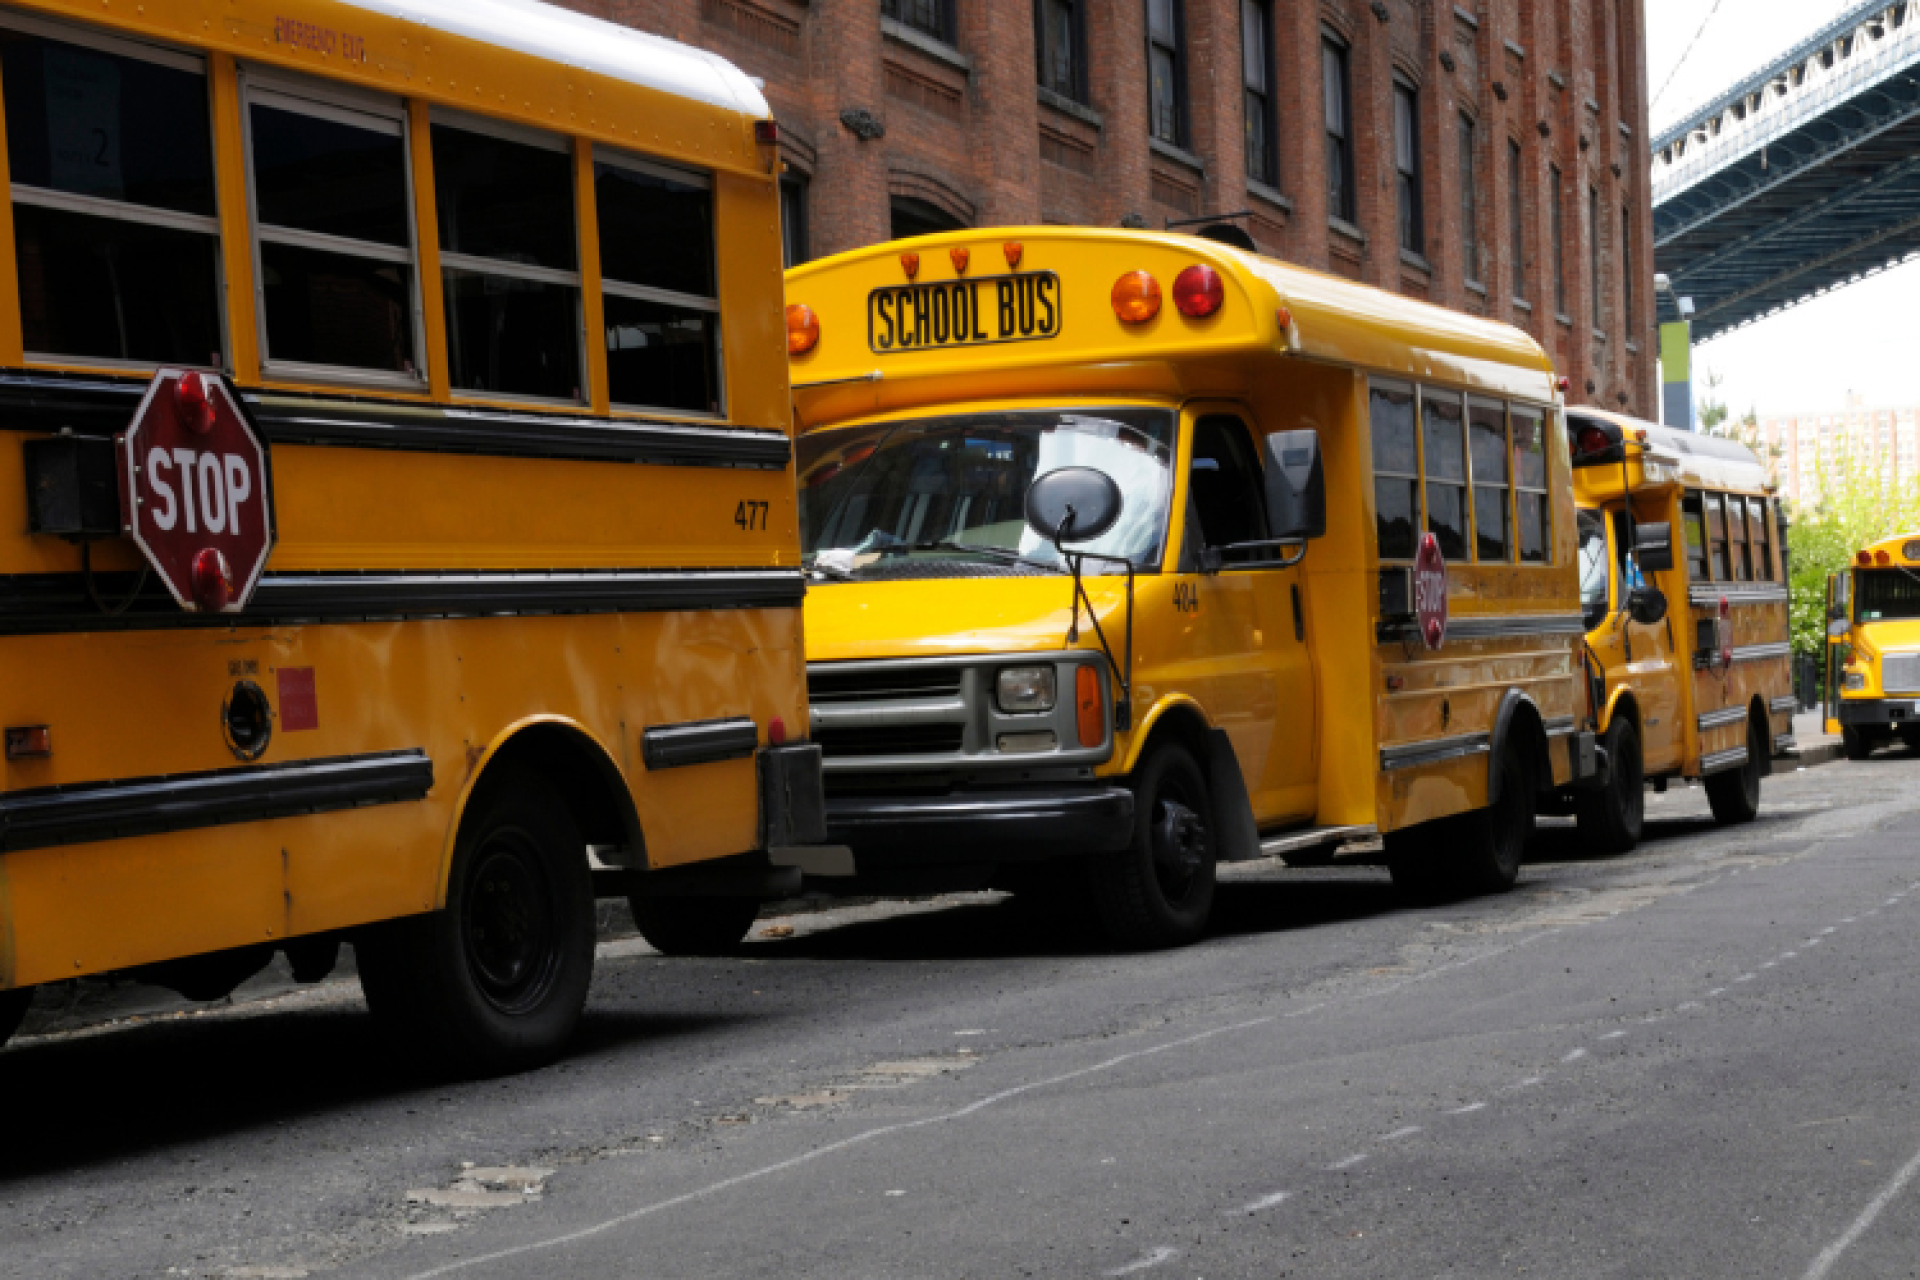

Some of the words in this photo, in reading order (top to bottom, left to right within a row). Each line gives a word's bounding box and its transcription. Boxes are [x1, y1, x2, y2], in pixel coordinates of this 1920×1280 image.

[275, 14, 338, 56] EMERGENCY
[342, 32, 365, 62] EXIT
[92, 127, 110, 167] 2
[877, 282, 989, 349] SCHOOL
[998, 274, 1055, 336] BUS
[147, 445, 252, 536] STOP
[734, 500, 769, 531] 477
[1172, 582, 1199, 613] 484
[1420, 570, 1443, 613] STOP
